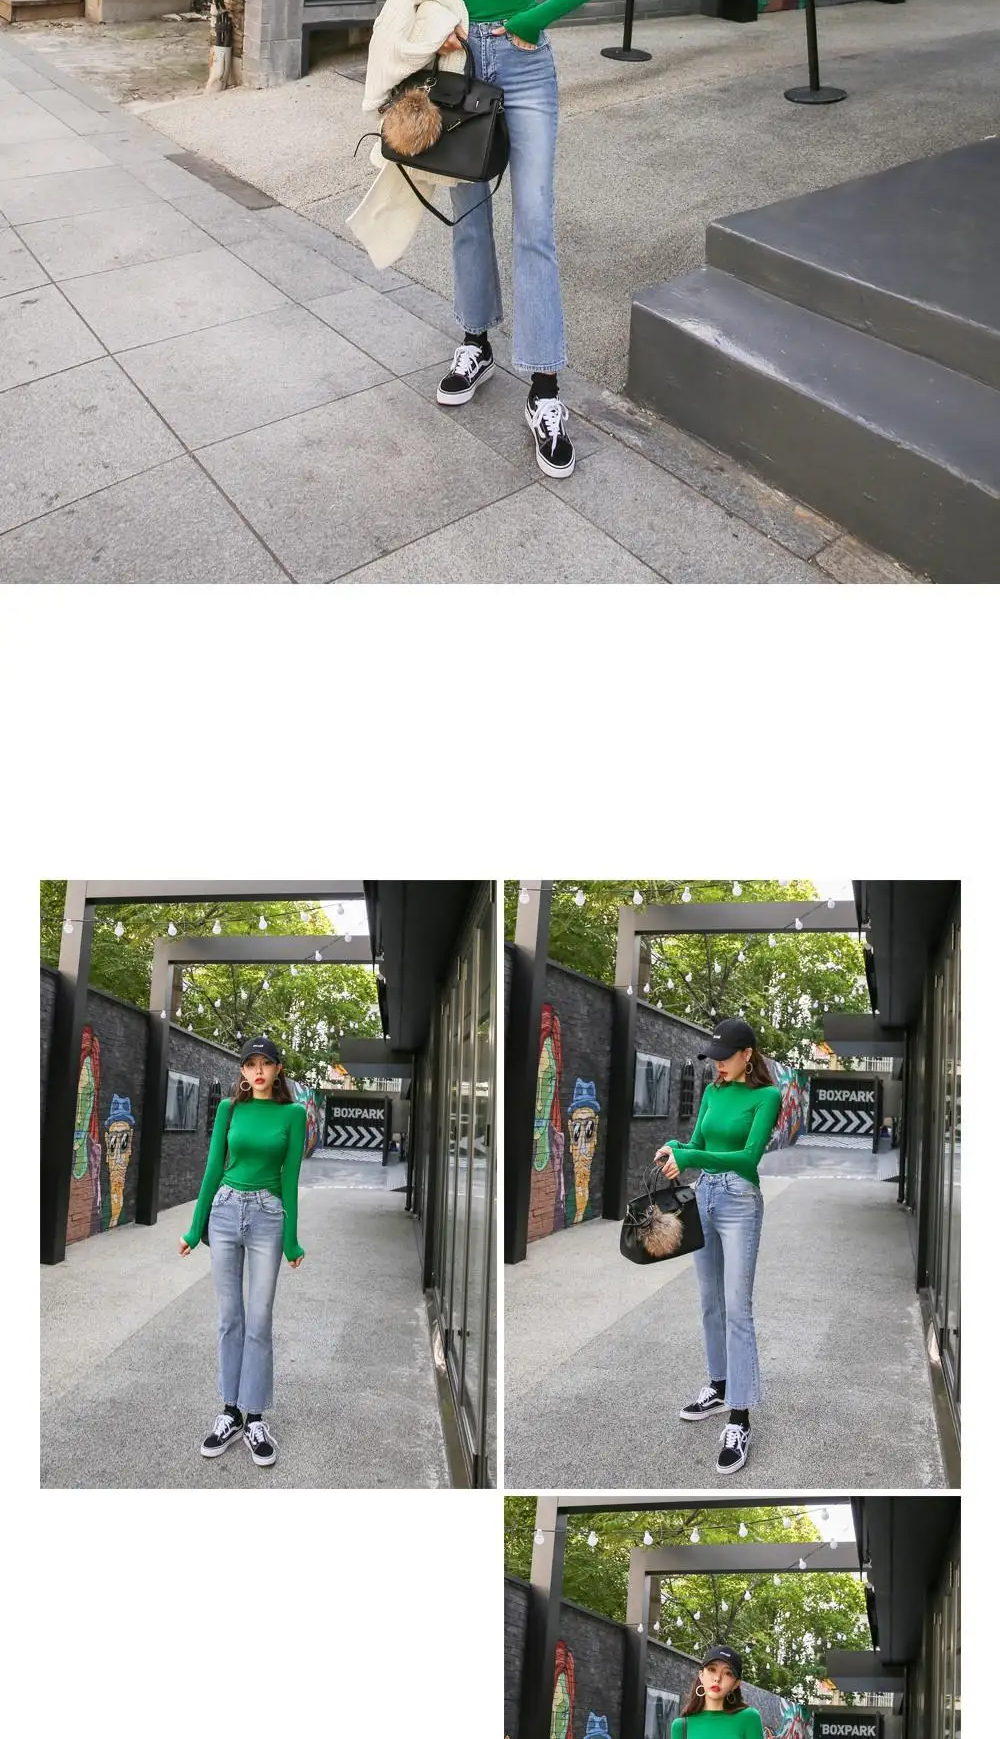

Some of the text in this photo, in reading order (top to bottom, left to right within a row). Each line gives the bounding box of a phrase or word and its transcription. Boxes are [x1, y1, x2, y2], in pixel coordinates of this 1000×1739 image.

[818, 1089, 875, 1103] BOXPARK
[333, 1107, 385, 1120] BOXPARK
[822, 1724, 877, 1737] BOXPARK
